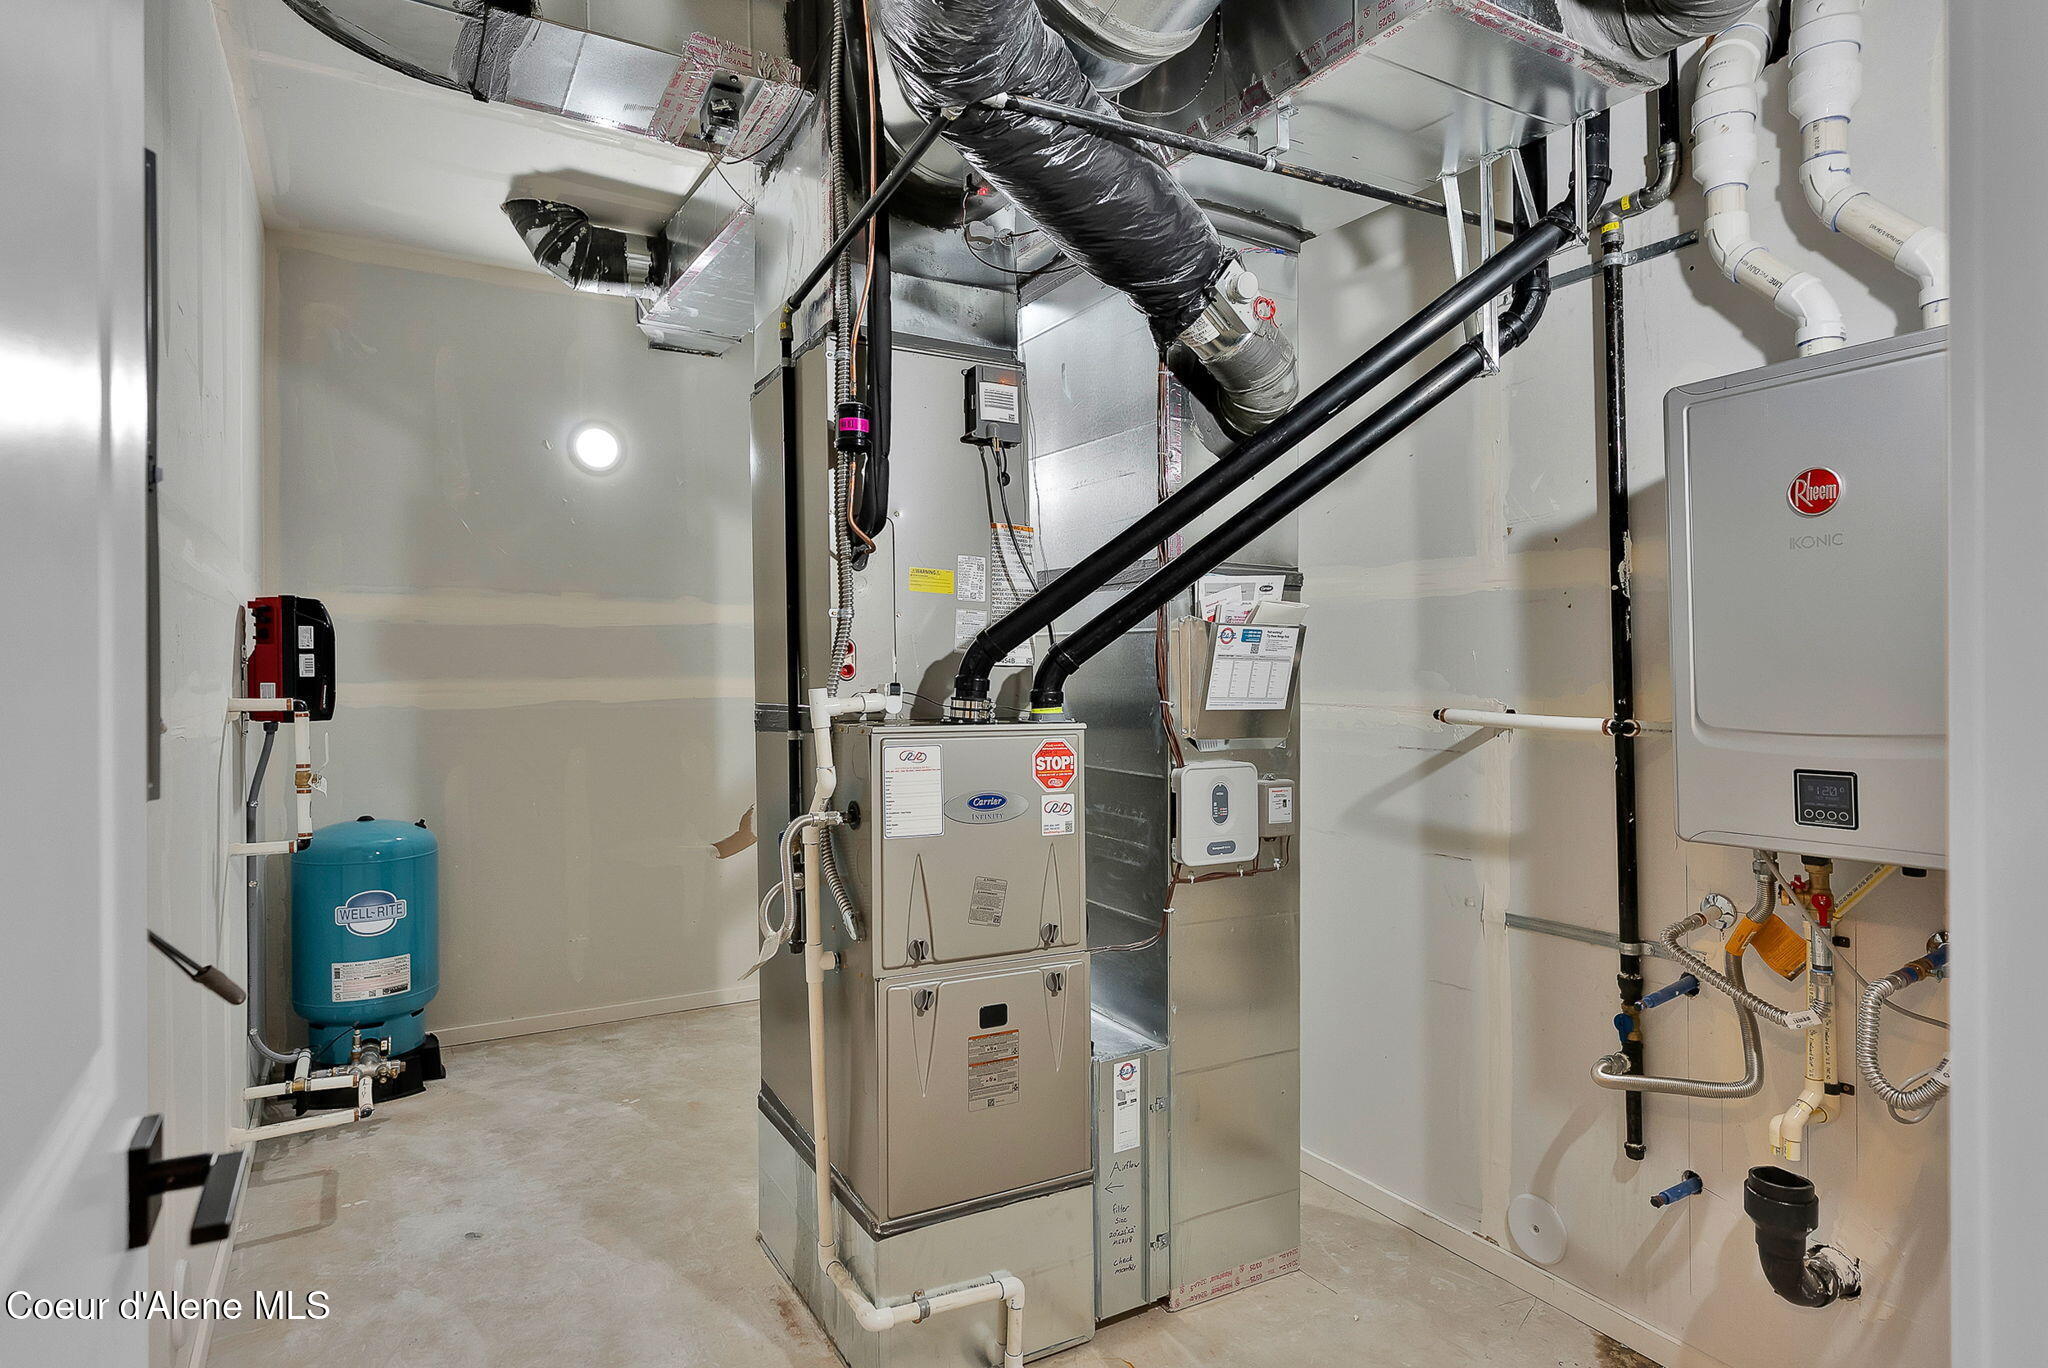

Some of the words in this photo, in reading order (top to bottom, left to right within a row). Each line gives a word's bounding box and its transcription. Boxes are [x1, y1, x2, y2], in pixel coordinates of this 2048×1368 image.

[1794, 471, 1837, 507] Rheem
[1036, 755, 1074, 771] STOP!
[973, 796, 1003, 808] Carrier
[971, 812, 1004, 822] INFINITY
